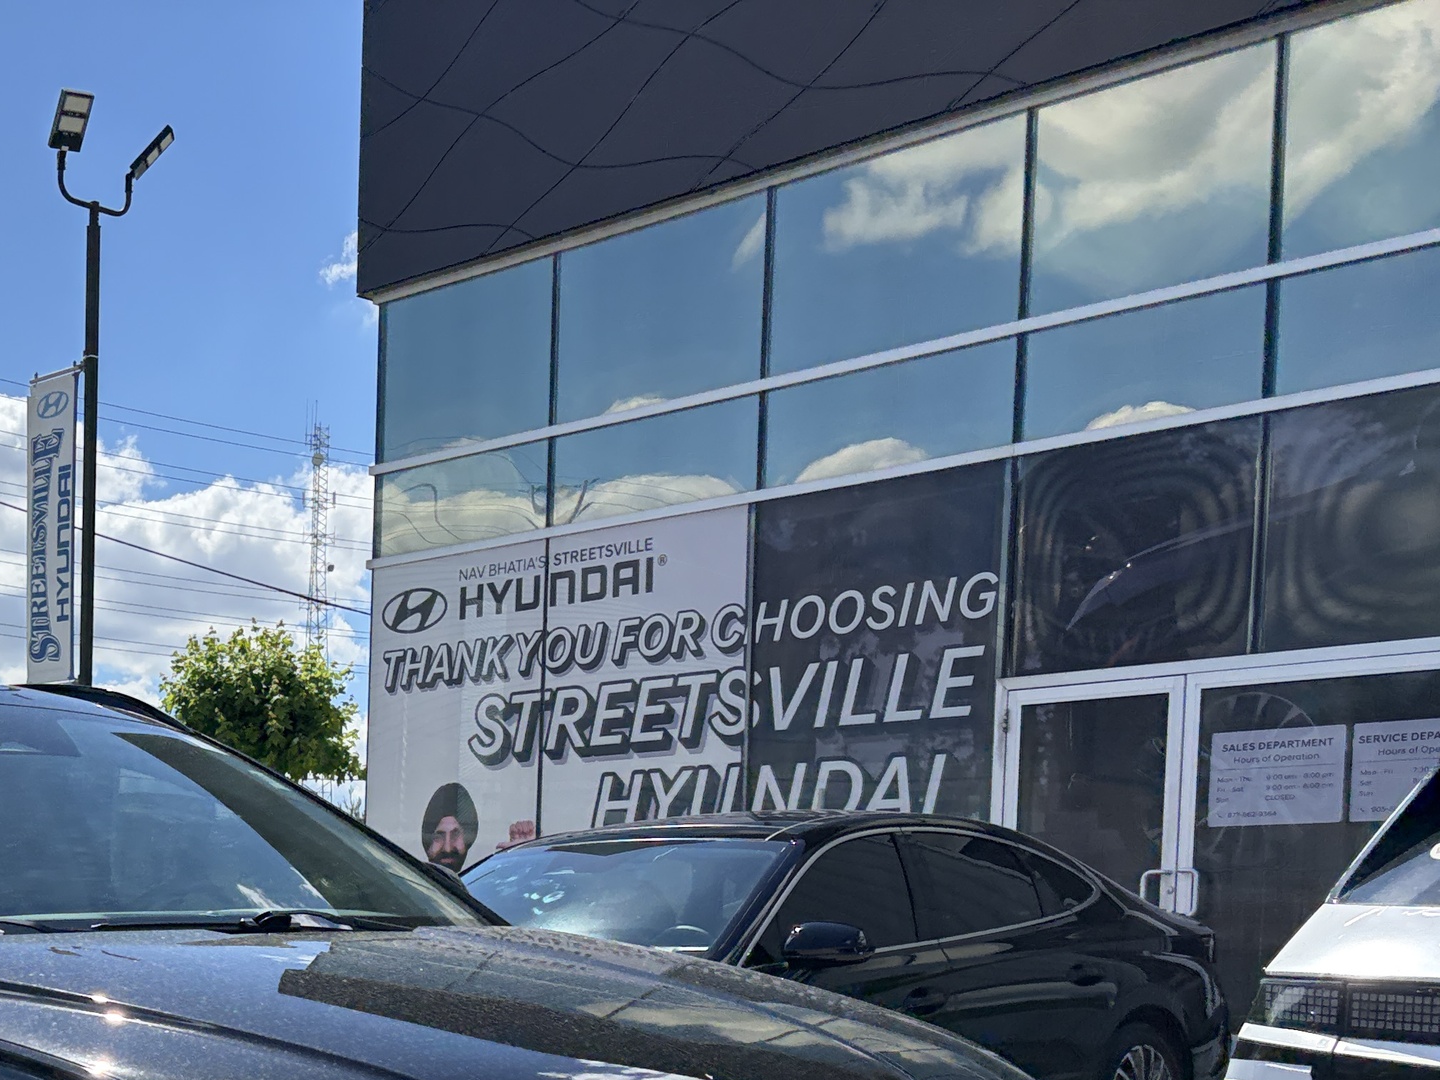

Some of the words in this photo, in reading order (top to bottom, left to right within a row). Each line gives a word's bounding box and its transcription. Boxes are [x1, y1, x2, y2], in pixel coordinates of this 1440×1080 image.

[30, 428, 64, 663] STREETSVILLE
[56, 463, 72, 624] HYUNDAI
[458, 565, 487, 582] NAV
[488, 555, 548, 578] BHATIA'S
[553, 537, 654, 567] STREETSVILLE
[459, 556, 655, 621] HYUNDAI
[383, 634, 515, 697] THANK
[515, 620, 611, 678] YOU
[611, 609, 708, 669] FOR
[710, 570, 1000, 657] CHOOSING
[468, 644, 986, 768] STREETSVILLE
[1221, 742, 1256, 753] SALES
[1257, 737, 1334, 750] DEPARTMENT
[1233, 756, 1260, 764] Hours
[1261, 755, 1272, 763] of
[1273, 753, 1320, 763] Operation
[1358, 732, 1408, 744] SERVICE
[1378, 748, 1406, 756] Hours
[1409, 745, 1419, 754] of
[1264, 794, 1296, 802] CLOSED
